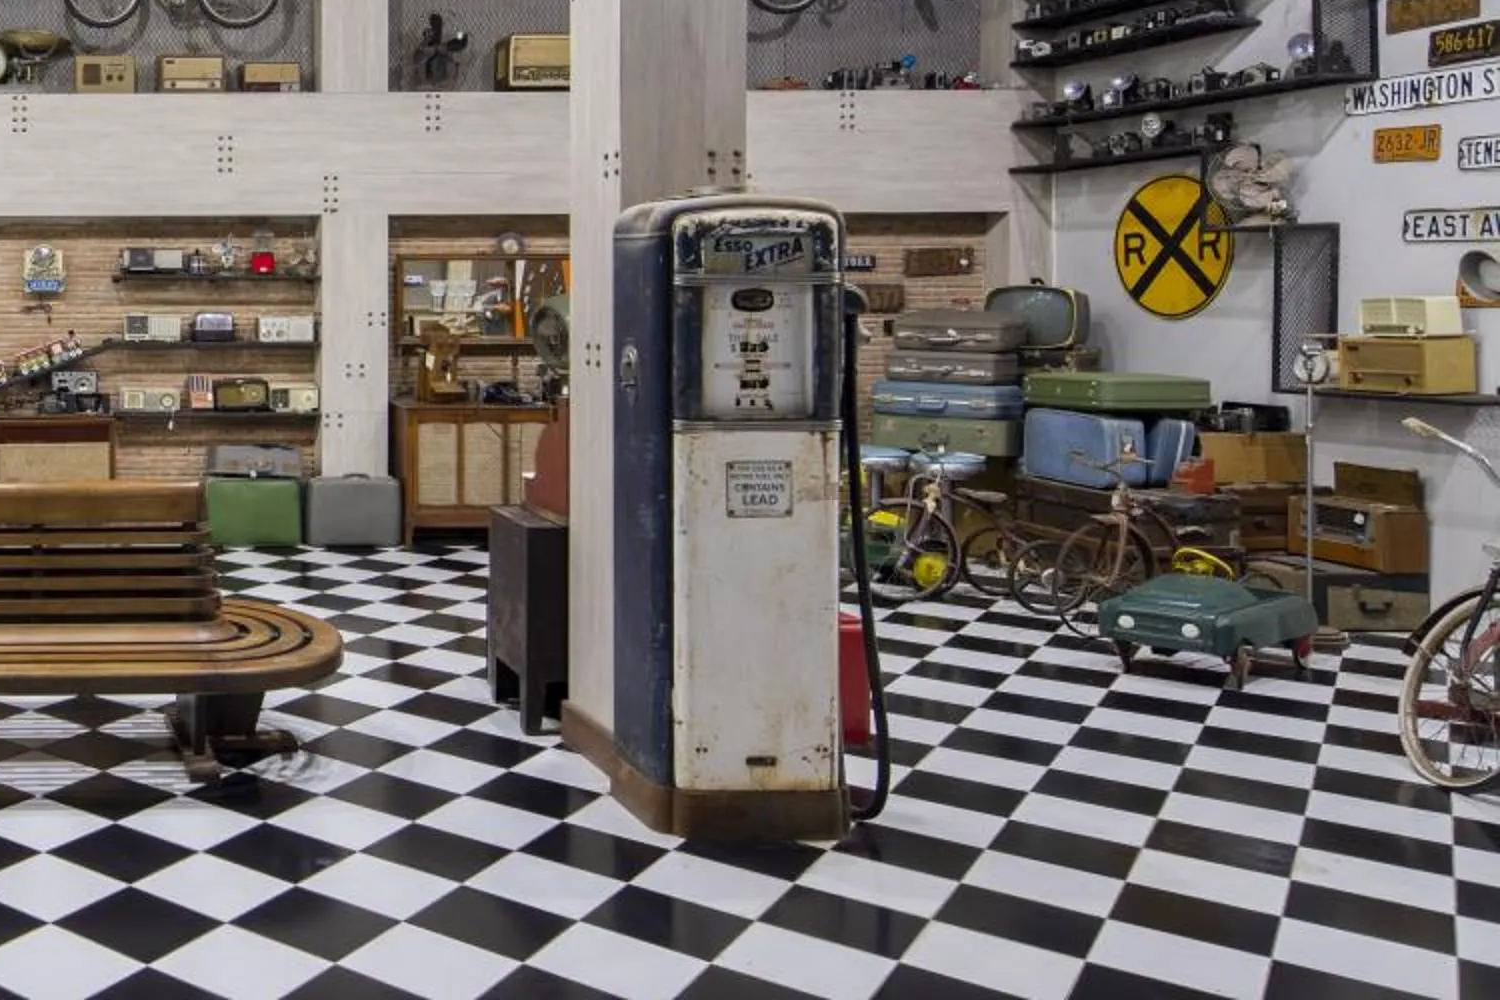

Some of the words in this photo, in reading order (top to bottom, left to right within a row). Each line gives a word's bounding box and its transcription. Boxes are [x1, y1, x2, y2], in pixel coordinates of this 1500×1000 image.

[1352, 71, 1473, 112] WASHINGTON
[1483, 67, 1500, 95] S
[1412, 214, 1470, 238] EAST
[744, 236, 805, 272] EXTRA
[1123, 232, 1146, 267] R
[1197, 227, 1221, 262] R
[734, 482, 785, 493] CONTAINS
[742, 493, 779, 506] LEAD
